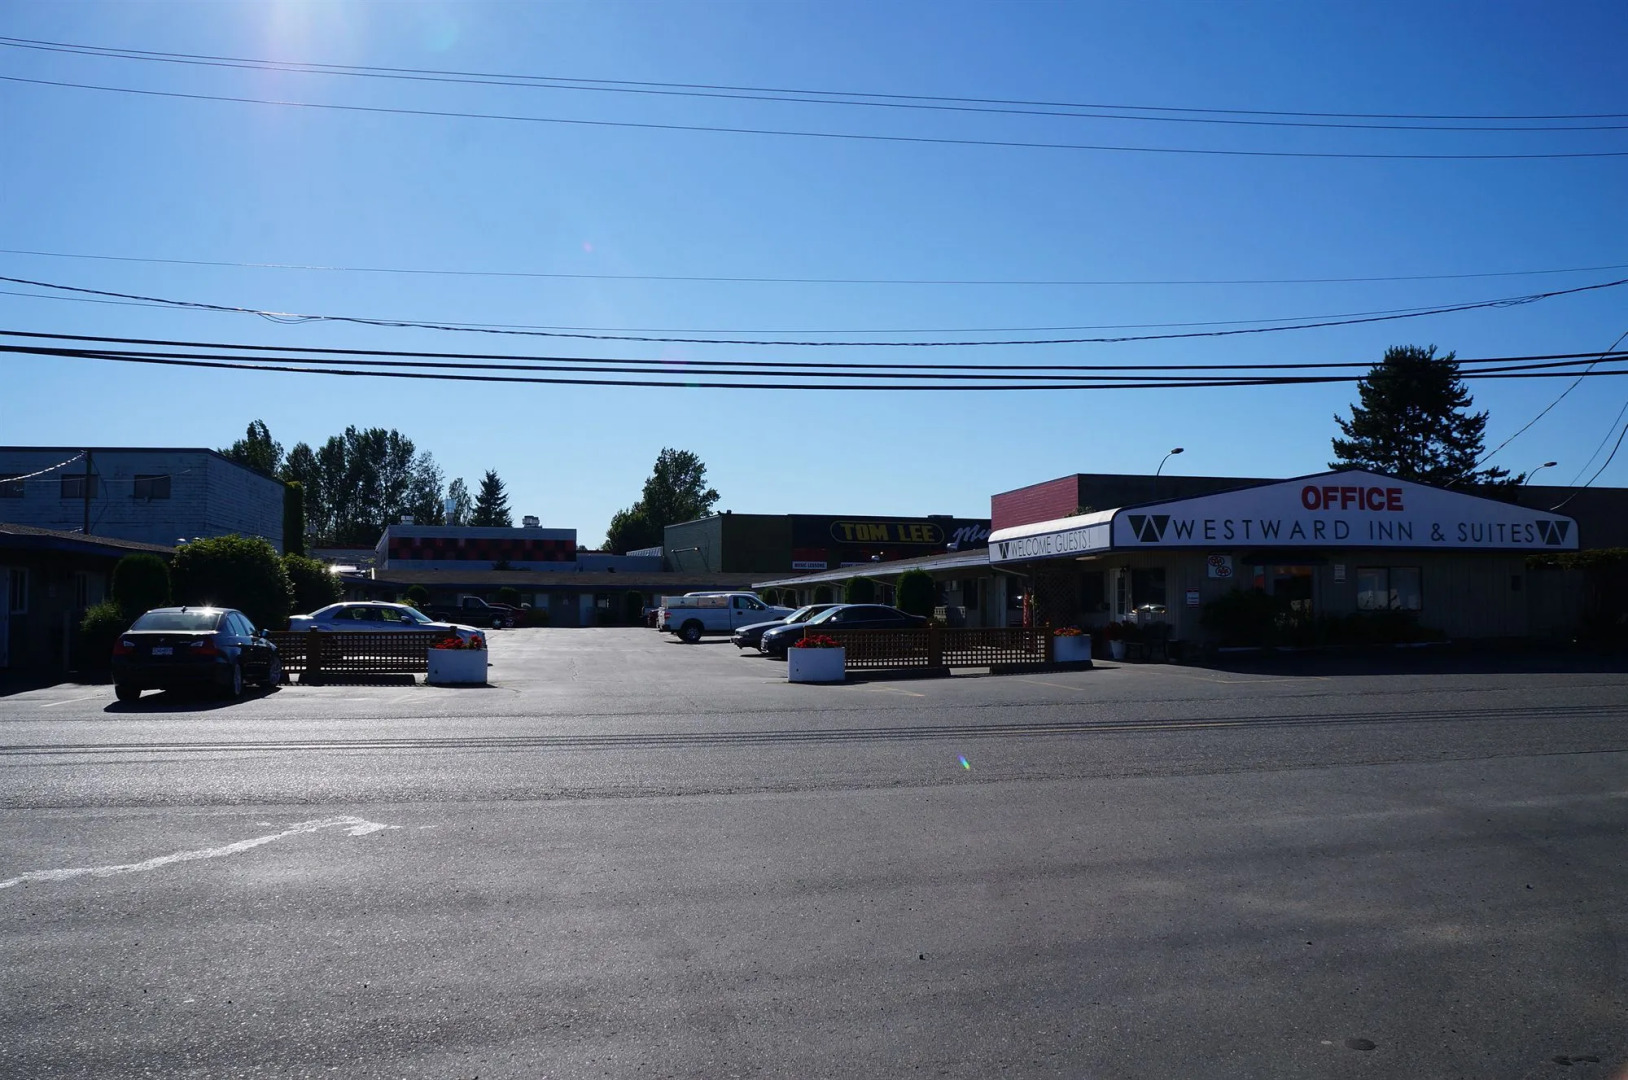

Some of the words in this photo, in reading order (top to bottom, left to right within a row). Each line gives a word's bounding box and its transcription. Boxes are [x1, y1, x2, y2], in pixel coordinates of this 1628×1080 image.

[1301, 486, 1404, 511] OFFICE
[840, 523, 890, 541] TOM
[898, 524, 935, 542] LEE
[1010, 537, 1051, 557] WELCOME
[1055, 529, 1091, 553] GUESTS!
[1173, 519, 1349, 540] WESTWARD
[1369, 521, 1412, 541] INN
[1431, 522, 1446, 542] &
[1457, 522, 1534, 543] SUITES
